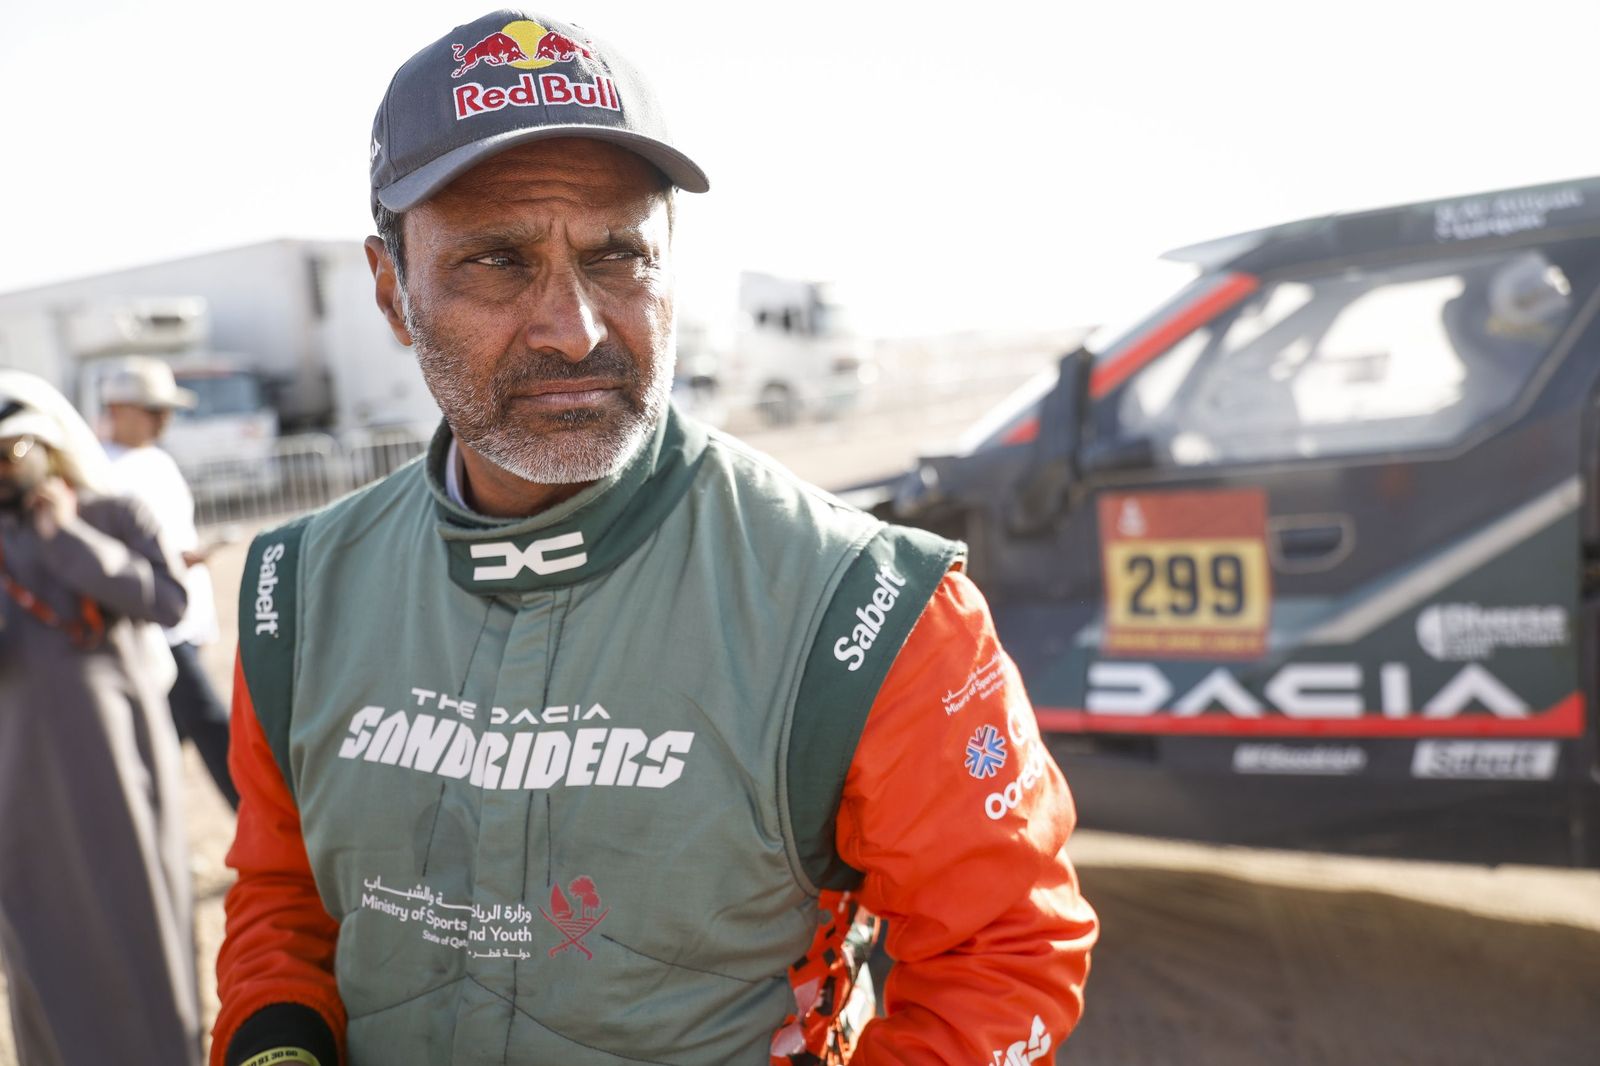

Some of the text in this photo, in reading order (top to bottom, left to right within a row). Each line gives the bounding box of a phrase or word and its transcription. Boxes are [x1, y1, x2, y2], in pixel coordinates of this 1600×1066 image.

[454, 74, 620, 120] Red Bull
[255, 543, 285, 635] Sabelt
[1126, 553, 1246, 617] 299
[833, 565, 906, 672] Sabelt
[411, 688, 611, 725] THE DACIA
[1085, 662, 1531, 718] DACIA
[338, 705, 695, 790] SANDRIDERS
[363, 874, 435, 906] والشباب
[504, 904, 532, 923] وزارة
[362, 893, 532, 942] Ministry of Sports nd Youth
